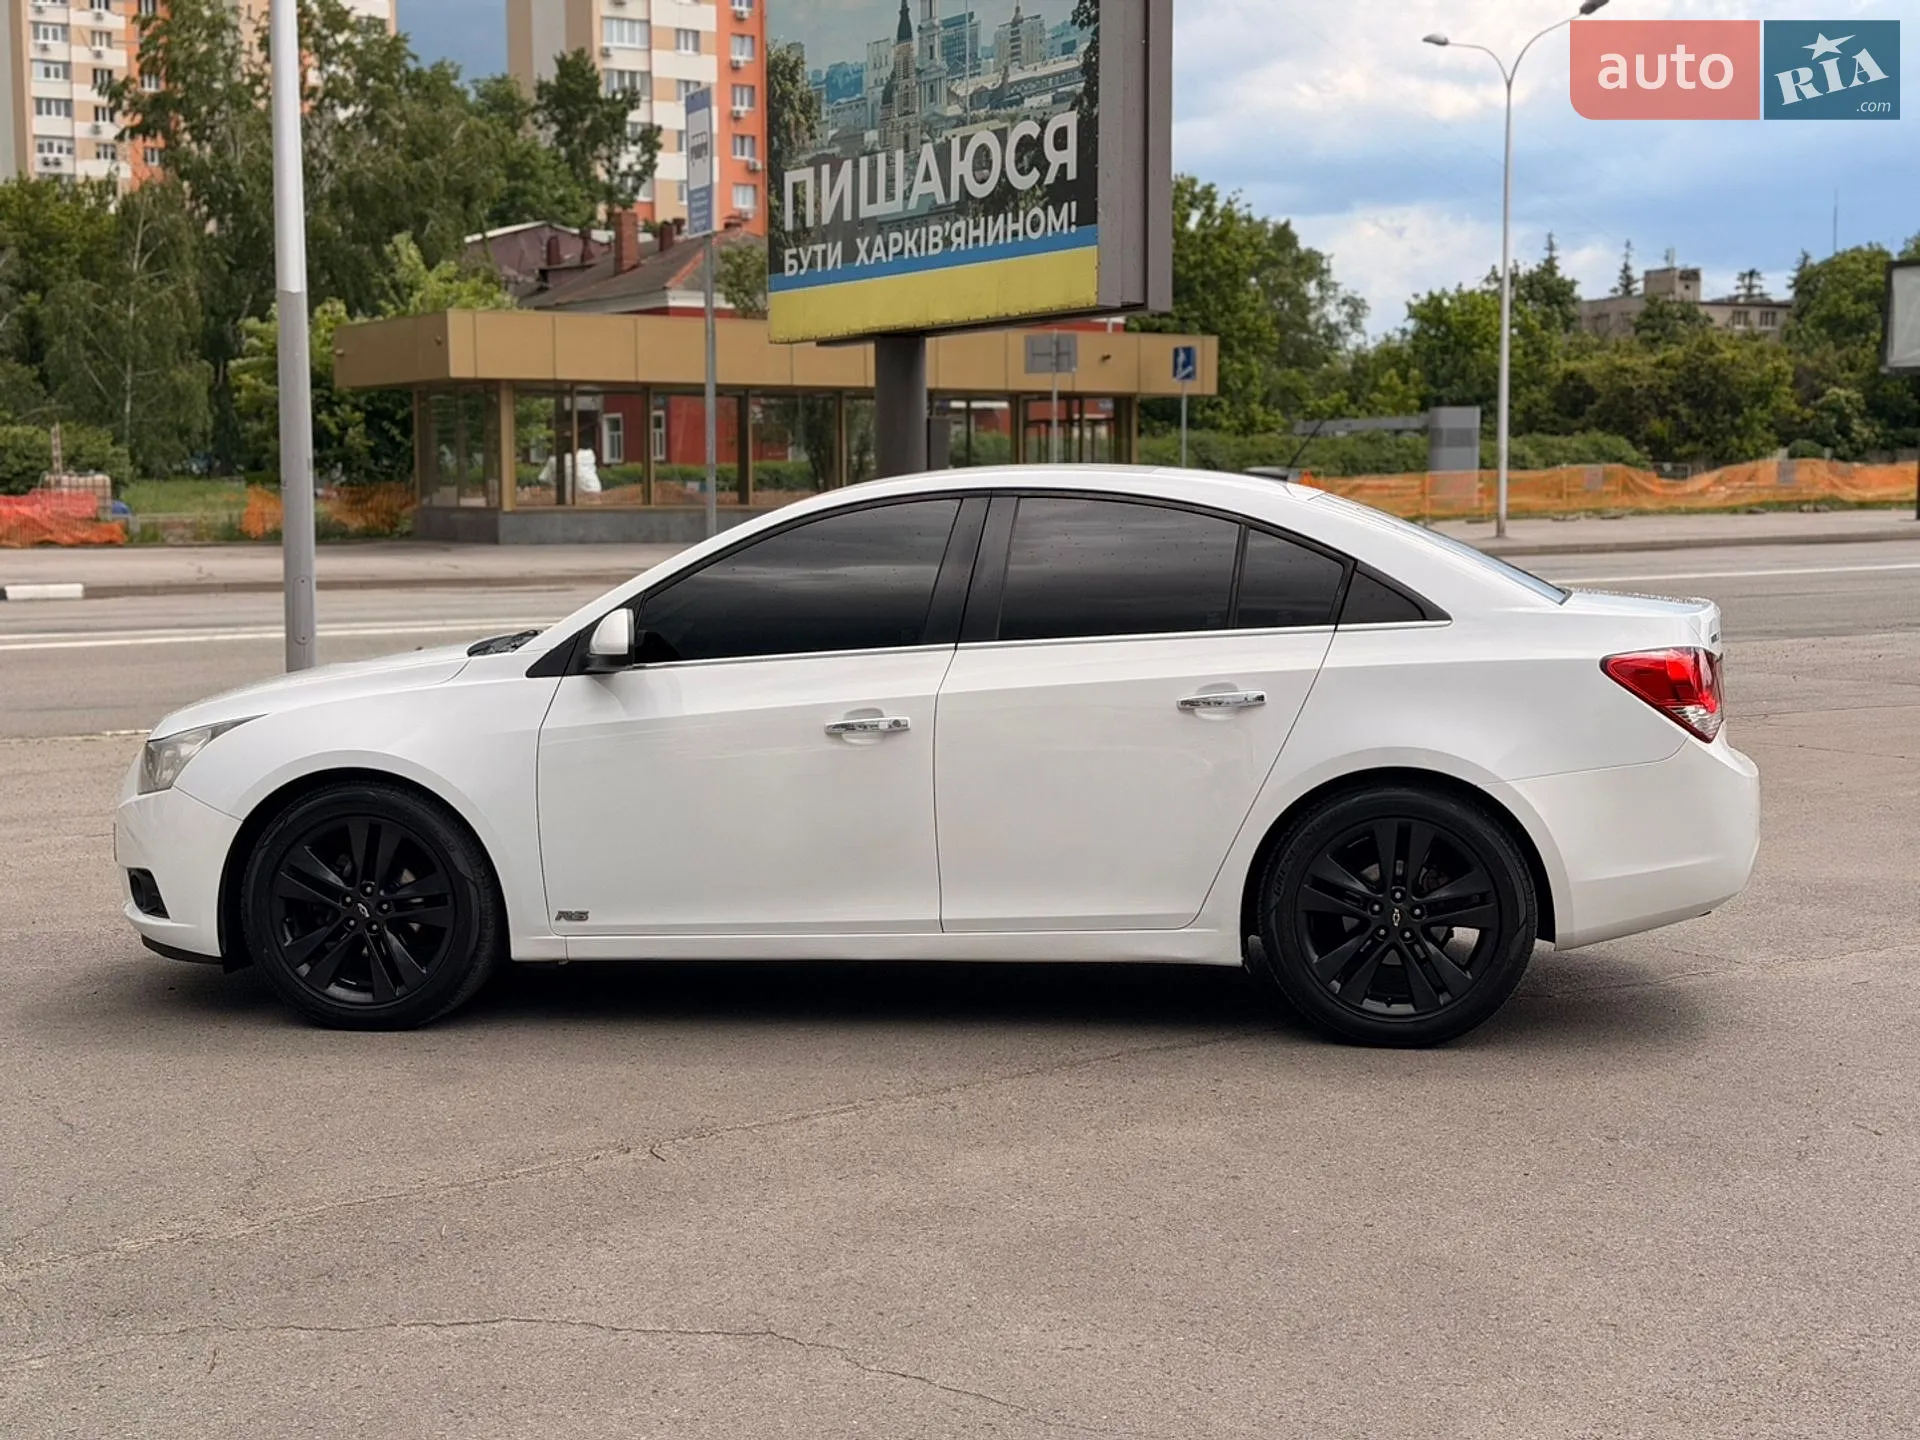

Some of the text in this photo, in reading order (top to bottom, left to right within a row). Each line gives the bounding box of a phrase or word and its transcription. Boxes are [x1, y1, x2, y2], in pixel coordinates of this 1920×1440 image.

[784, 110, 1078, 231] ПИШАЮСЯ
[784, 242, 842, 277] БУТИ
[555, 910, 590, 922] RS
